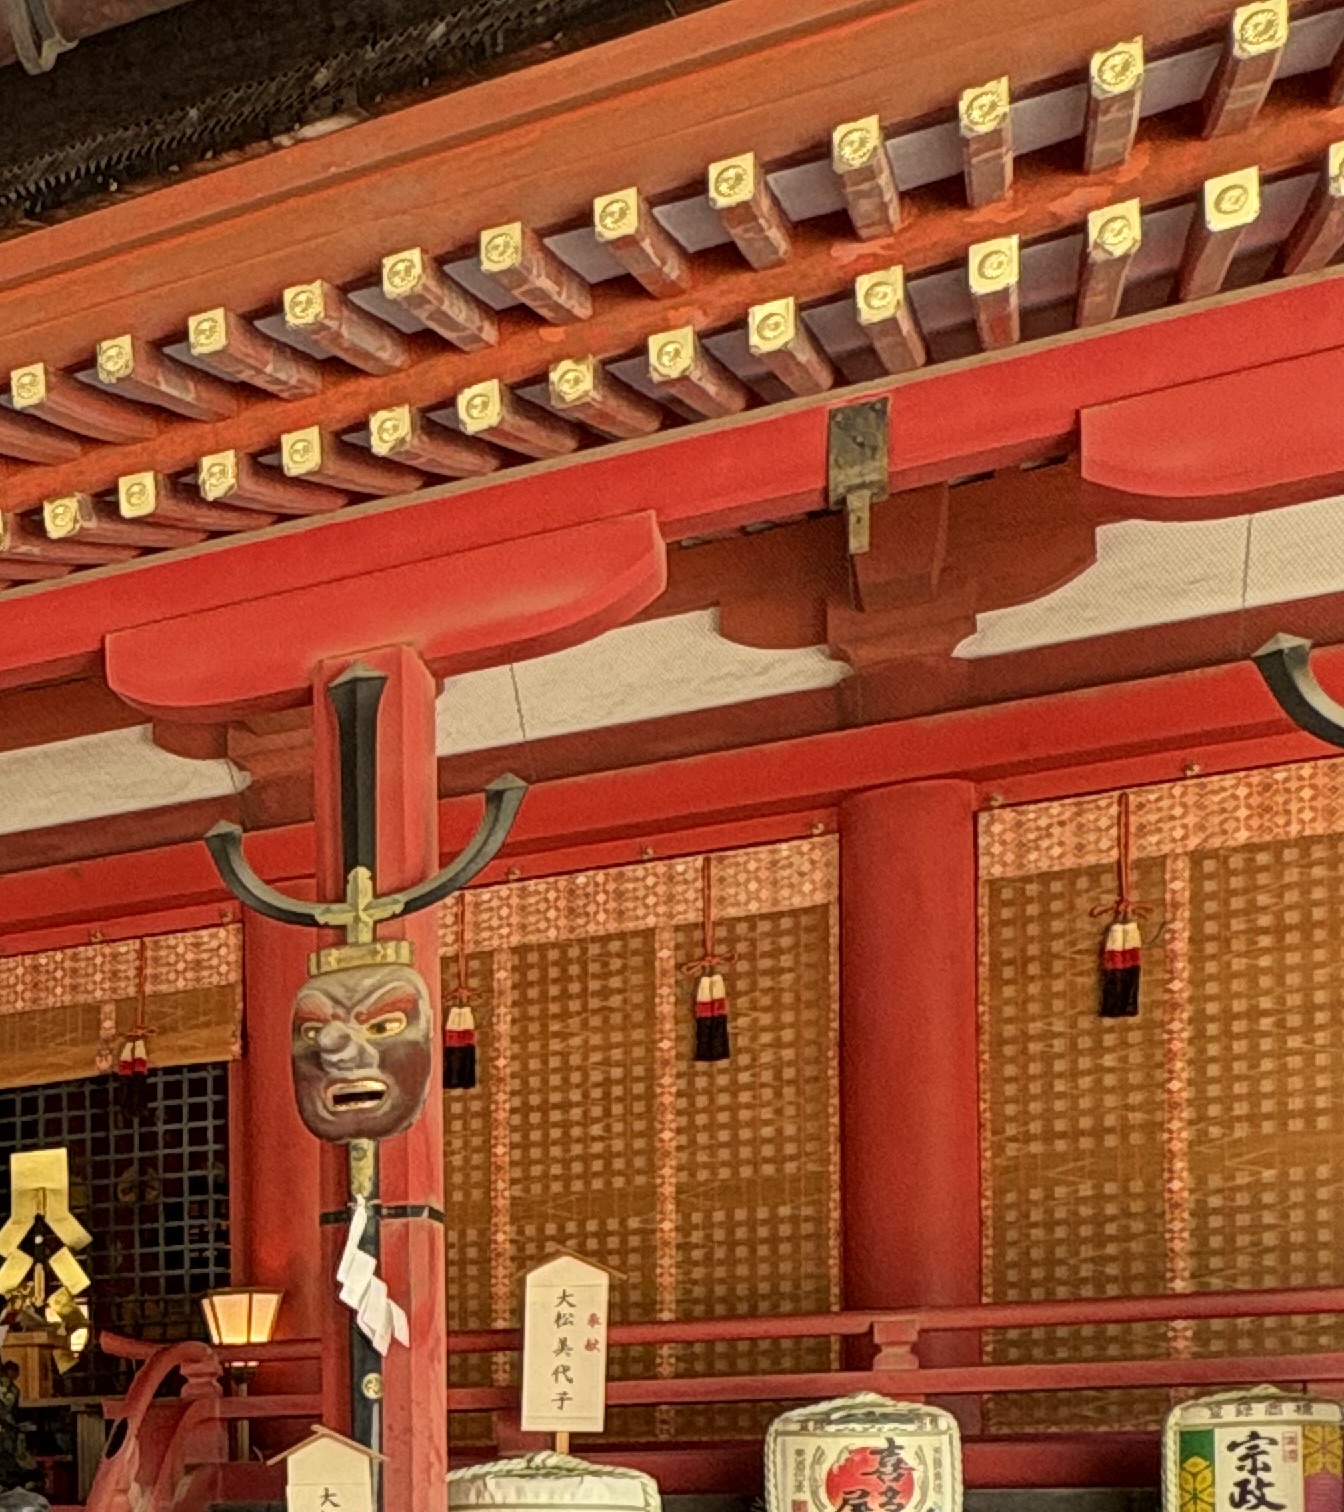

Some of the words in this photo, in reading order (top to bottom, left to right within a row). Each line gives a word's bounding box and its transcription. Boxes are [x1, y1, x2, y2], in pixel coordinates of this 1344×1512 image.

[551, 1288, 576, 1412] 大松美代子
[1226, 1430, 1288, 1512] 宗政
